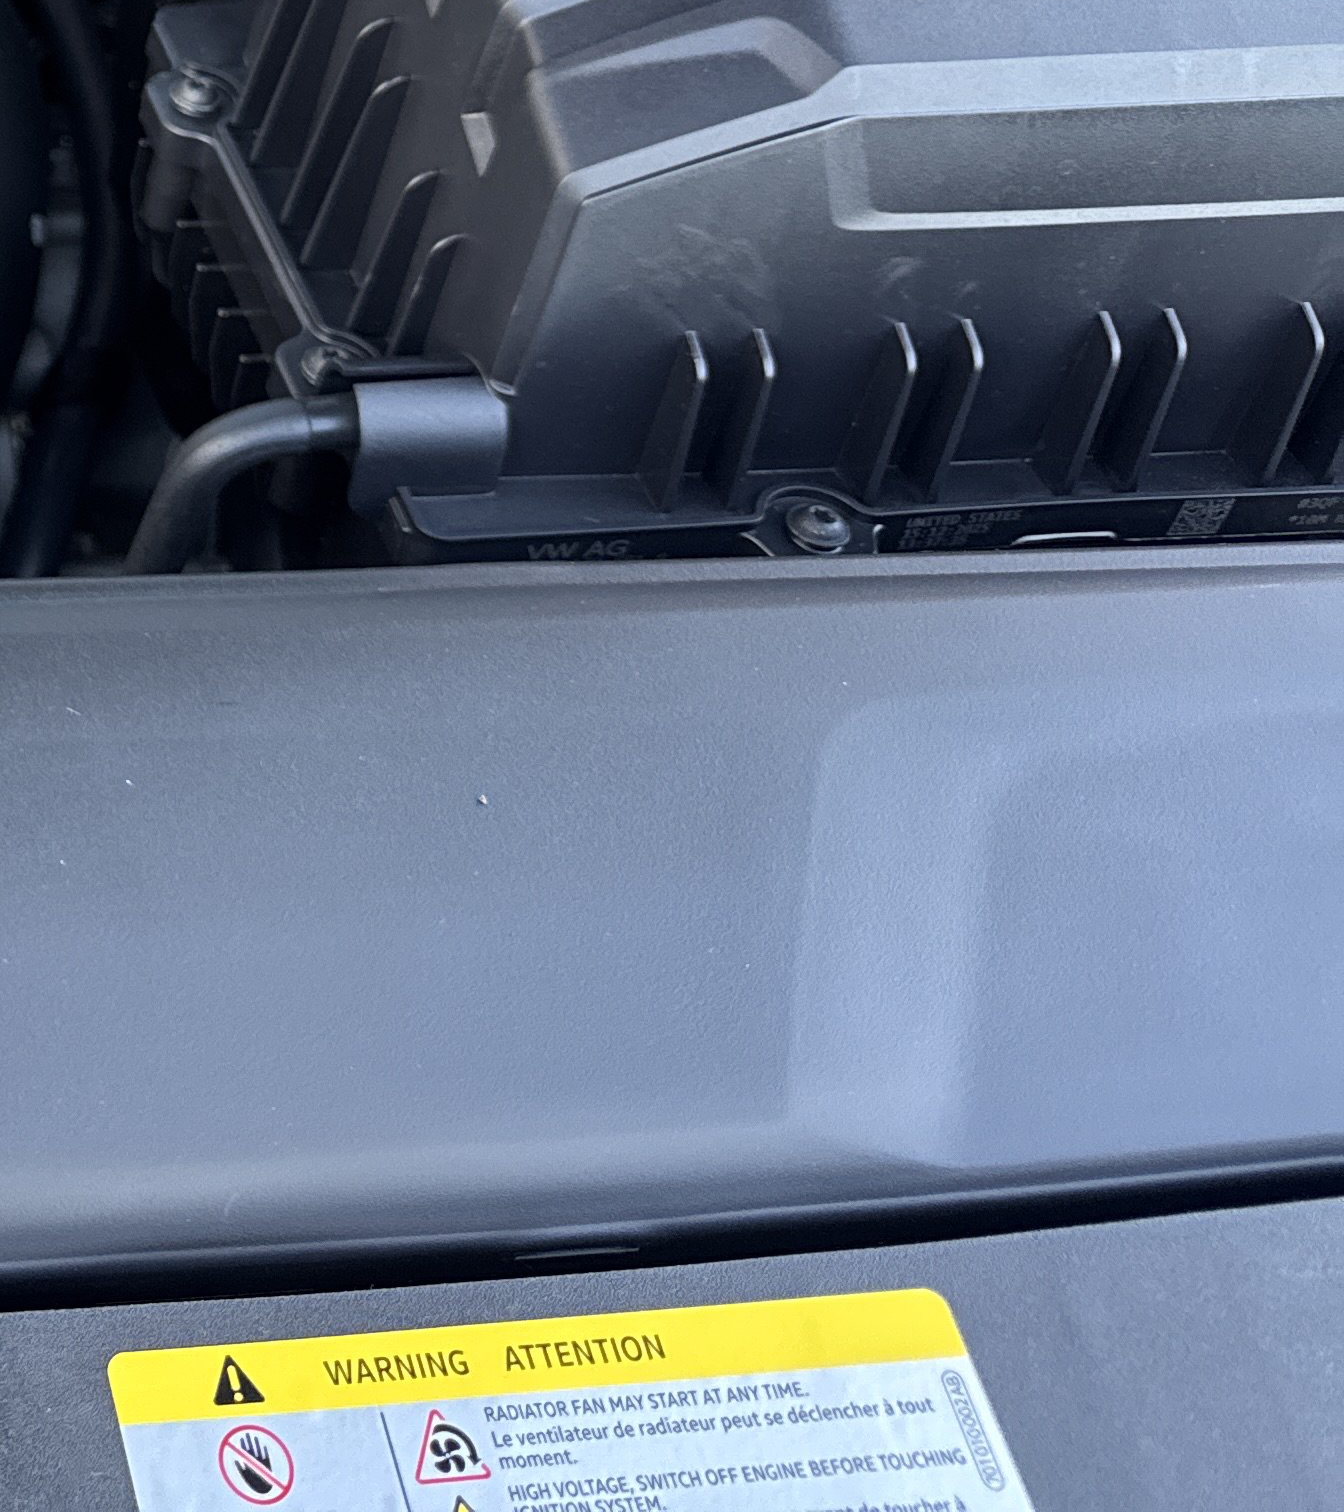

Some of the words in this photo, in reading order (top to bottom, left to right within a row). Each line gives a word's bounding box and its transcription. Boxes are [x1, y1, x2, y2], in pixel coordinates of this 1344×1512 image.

[527, 541, 579, 559] VW
[582, 539, 630, 557] AG
[322, 1349, 470, 1386] WARNING
[504, 1334, 667, 1372] ATTENTION
[484, 1399, 569, 1423] RADIATOR
[571, 1397, 607, 1416] FAN
[608, 1393, 645, 1413] MAY
[647, 1390, 699, 1411] START
[703, 1388, 722, 1405] AT
[726, 1383, 760, 1404] ANY
[761, 1381, 810, 1400] TIME.
[490, 1430, 514, 1449] Le
[515, 1424, 609, 1446] ventilateur
[612, 1420, 636, 1440] de
[638, 1415, 716, 1437] radiateur
[721, 1409, 763, 1434] peut
[763, 1410, 784, 1427] se
[787, 1401, 880, 1425] déclencher
[883, 1397, 896, 1417] à
[899, 1396, 936, 1415] tout
[498, 1449, 579, 1471] moment.
[507, 1481, 553, 1503] HIGH
[552, 1475, 635, 1499] VOLTAGE,
[635, 1469, 703, 1493] SWITCH
[704, 1467, 739, 1487] OFF
[742, 1461, 808, 1484] ENGINE
[809, 1454, 878, 1478] BEFORE
[878, 1448, 967, 1472] TOUCHING
